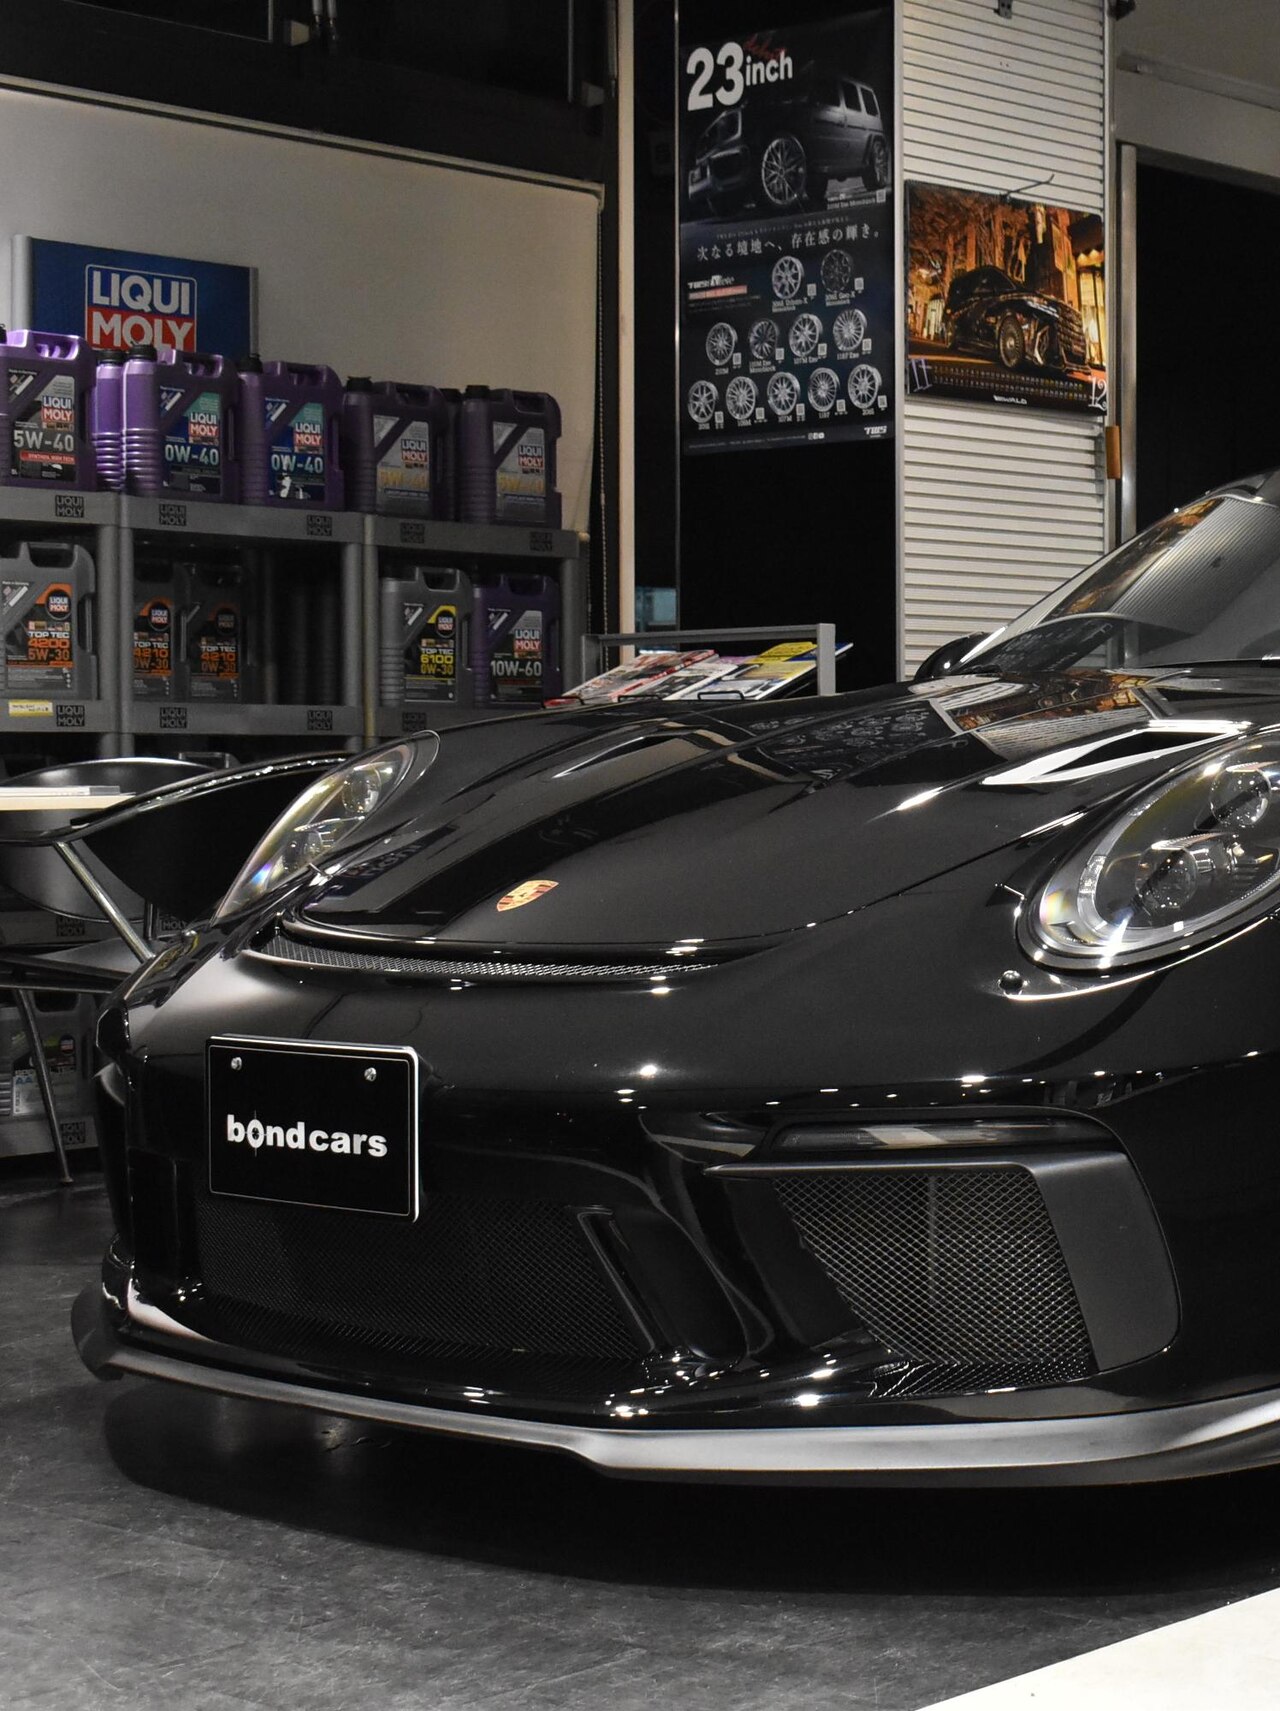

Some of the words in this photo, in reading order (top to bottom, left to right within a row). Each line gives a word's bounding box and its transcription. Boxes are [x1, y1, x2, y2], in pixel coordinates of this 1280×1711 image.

[92, 270, 190, 315] LIQUI
[92, 311, 193, 351] MOLY
[43, 397, 72, 408] LIQUI
[43, 408, 73, 421] MOLY
[190, 413, 217, 425] LIQUI
[190, 424, 218, 436] MOLY
[295, 423, 321, 434] LIQUI
[13, 430, 75, 452] 5W-40
[295, 434, 322, 445] MOLY
[402, 439, 427, 450] LIQUI
[165, 444, 219, 465] 0W-40
[518, 445, 542, 456] LIQUI
[402, 451, 428, 462] MOLY
[518, 456, 543, 468] MOLY
[271, 454, 324, 474] 0W-40
[56, 496, 84, 506] LIQUI
[57, 507, 84, 517] MOLY
[160, 505, 186, 514] LIQUI
[160, 515, 186, 525] MOLY
[50, 596, 68, 604] LIQUI
[50, 604, 69, 612] MOLY
[28, 631, 49, 639] TOP
[515, 630, 540, 640] LIQUI
[28, 638, 70, 648] 4200
[515, 640, 541, 650] MOLY
[29, 648, 70, 661] 5W-30
[201, 652, 236, 662] 4210
[421, 655, 454, 664] 6100
[421, 664, 454, 675] 0W-30
[490, 660, 542, 676] 10W-60
[58, 706, 85, 716] LIQUI
[161, 708, 187, 717] LIQUI
[58, 717, 85, 726] MOLY
[161, 718, 187, 728] MOLY
